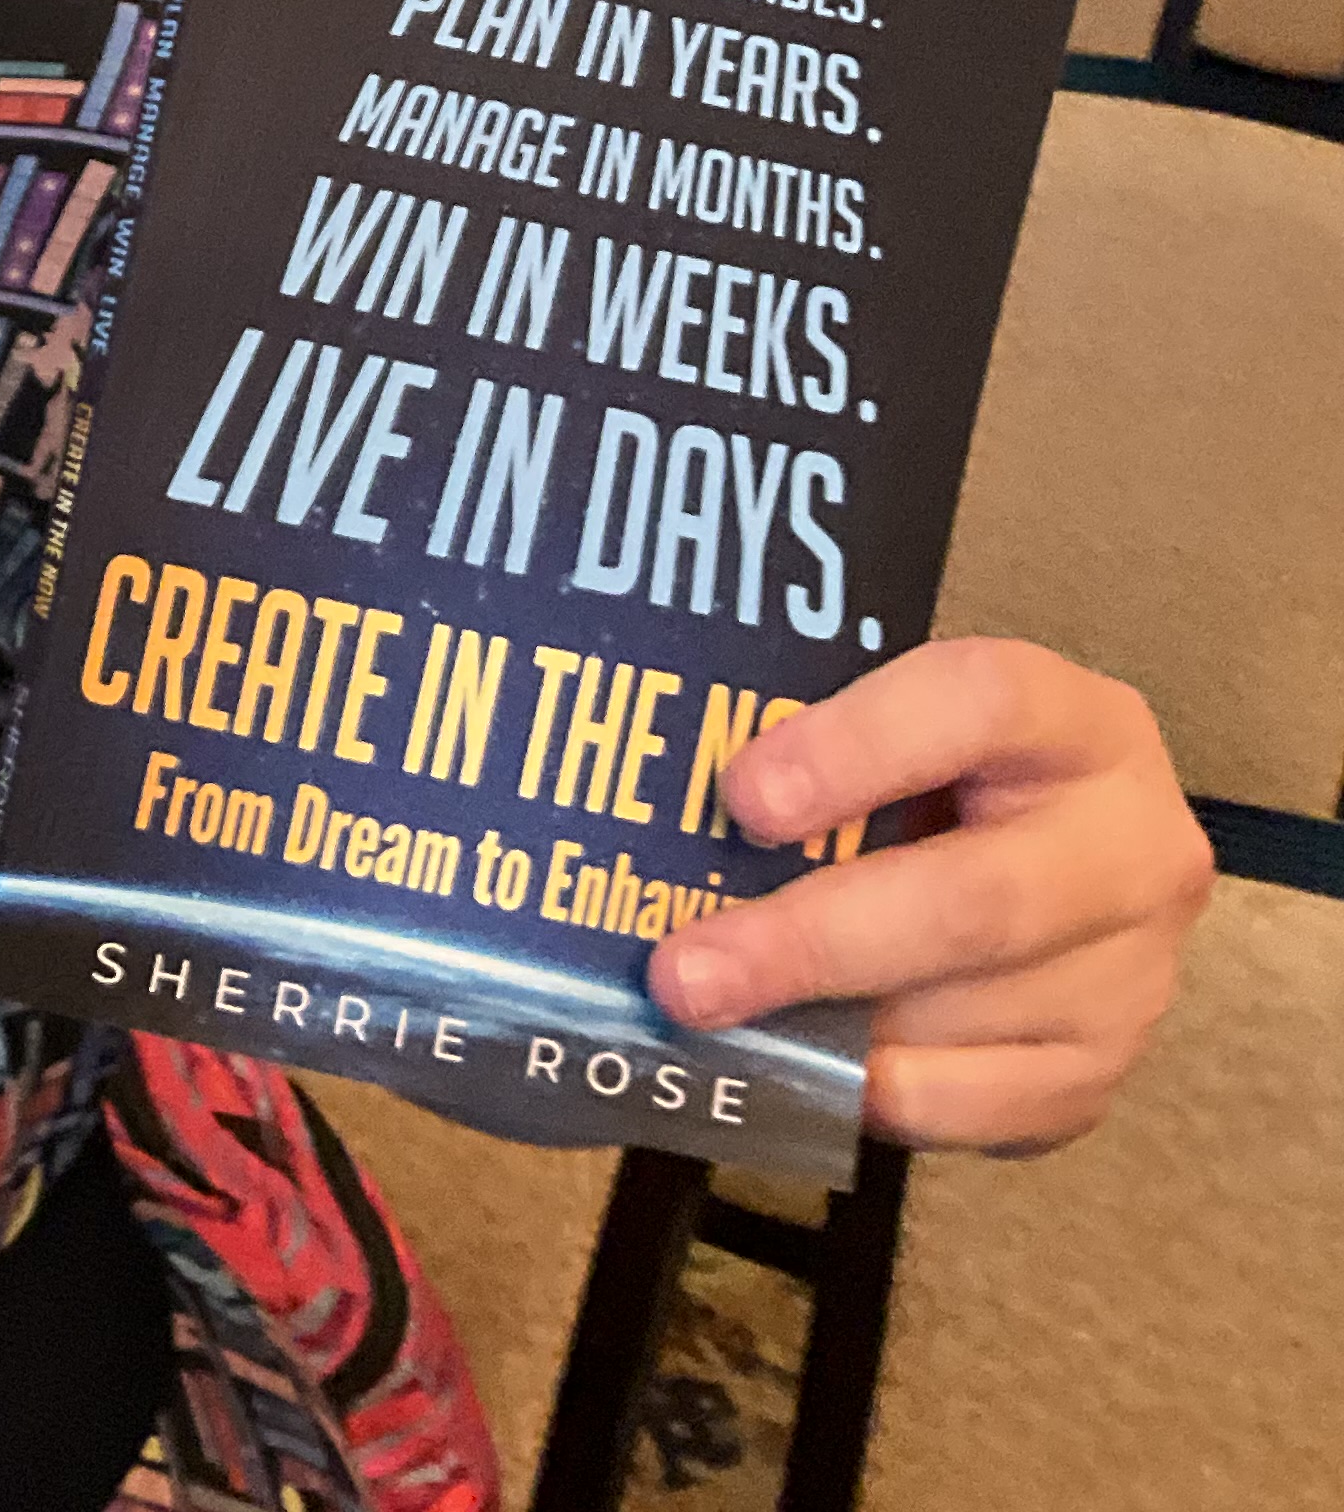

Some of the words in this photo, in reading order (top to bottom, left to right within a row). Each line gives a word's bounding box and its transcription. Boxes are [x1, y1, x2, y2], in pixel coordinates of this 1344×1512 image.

[575, 0, 651, 88] IN
[669, 16, 883, 144] YEARS.
[338, 73, 576, 188] MANAGE
[578, 123, 641, 203] IN
[648, 138, 884, 260] MONTHS.
[279, 175, 469, 326] WIN
[466, 216, 570, 351] IN
[585, 236, 879, 423] WEEKS.
[44, 514, 70, 564] THE
[54, 486, 75, 515] IN
[166, 326, 439, 544] LIVE
[425, 378, 565, 576] IN
[570, 406, 884, 652] DAYS.
[33, 561, 59, 620] NOW
[80, 553, 405, 764] CREATE
[402, 623, 510, 788] IN
[517, 645, 683, 824] THE
[134, 751, 275, 857] From
[282, 783, 462, 898] Dream
[473, 829, 532, 913] to
[91, 941, 469, 1064] SHERRIE
[527, 1037, 750, 1125] ROSE
